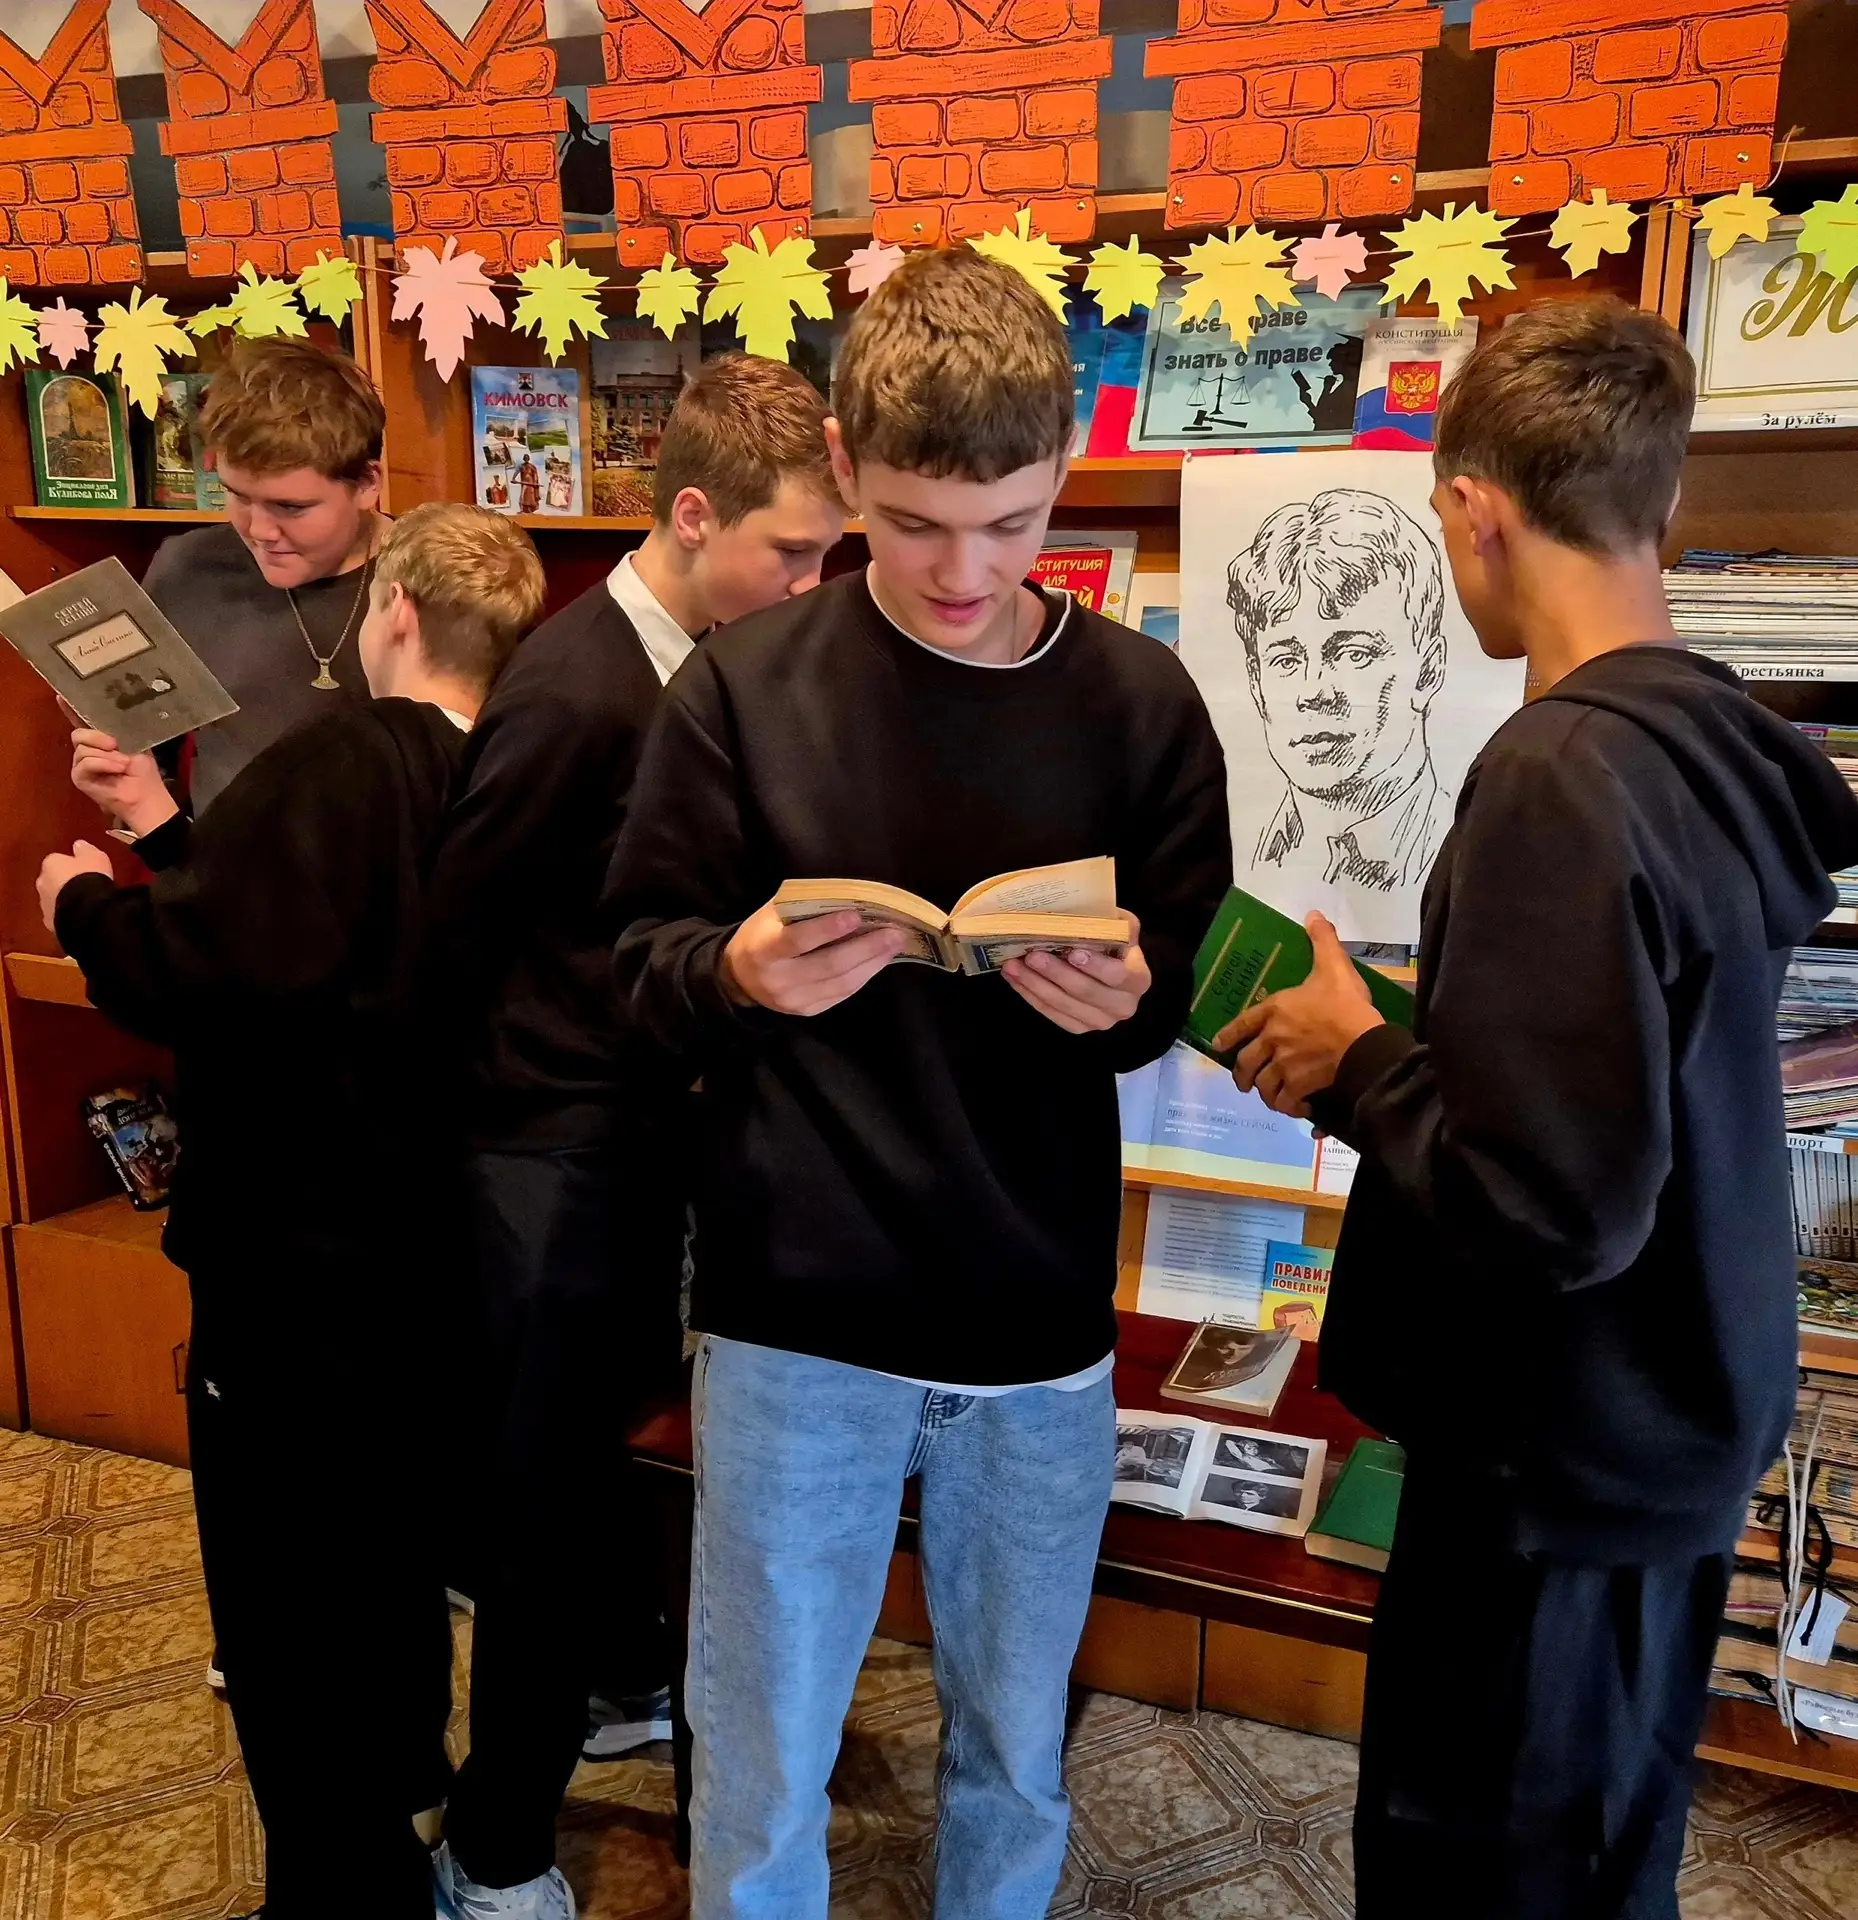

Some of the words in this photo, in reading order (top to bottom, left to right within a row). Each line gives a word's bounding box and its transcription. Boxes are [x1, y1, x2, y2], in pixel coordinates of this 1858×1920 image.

[1164, 352, 1228, 370] знать
[1234, 351, 1248, 367] о
[1254, 346, 1323, 369] праве
[484, 391, 569, 408] КИМОВСК
[1761, 413, 1779, 426] За
[1785, 411, 1837, 429] рулём
[1032, 558, 1104, 573] СТИТУЦИЯ
[1042, 574, 1068, 587] ДЛЯ
[1788, 1137, 1826, 1150] порт
[1274, 1262, 1331, 1282] ПРАВИЛ
[1272, 1278, 1327, 1295] ПОВЕДЕНИ
